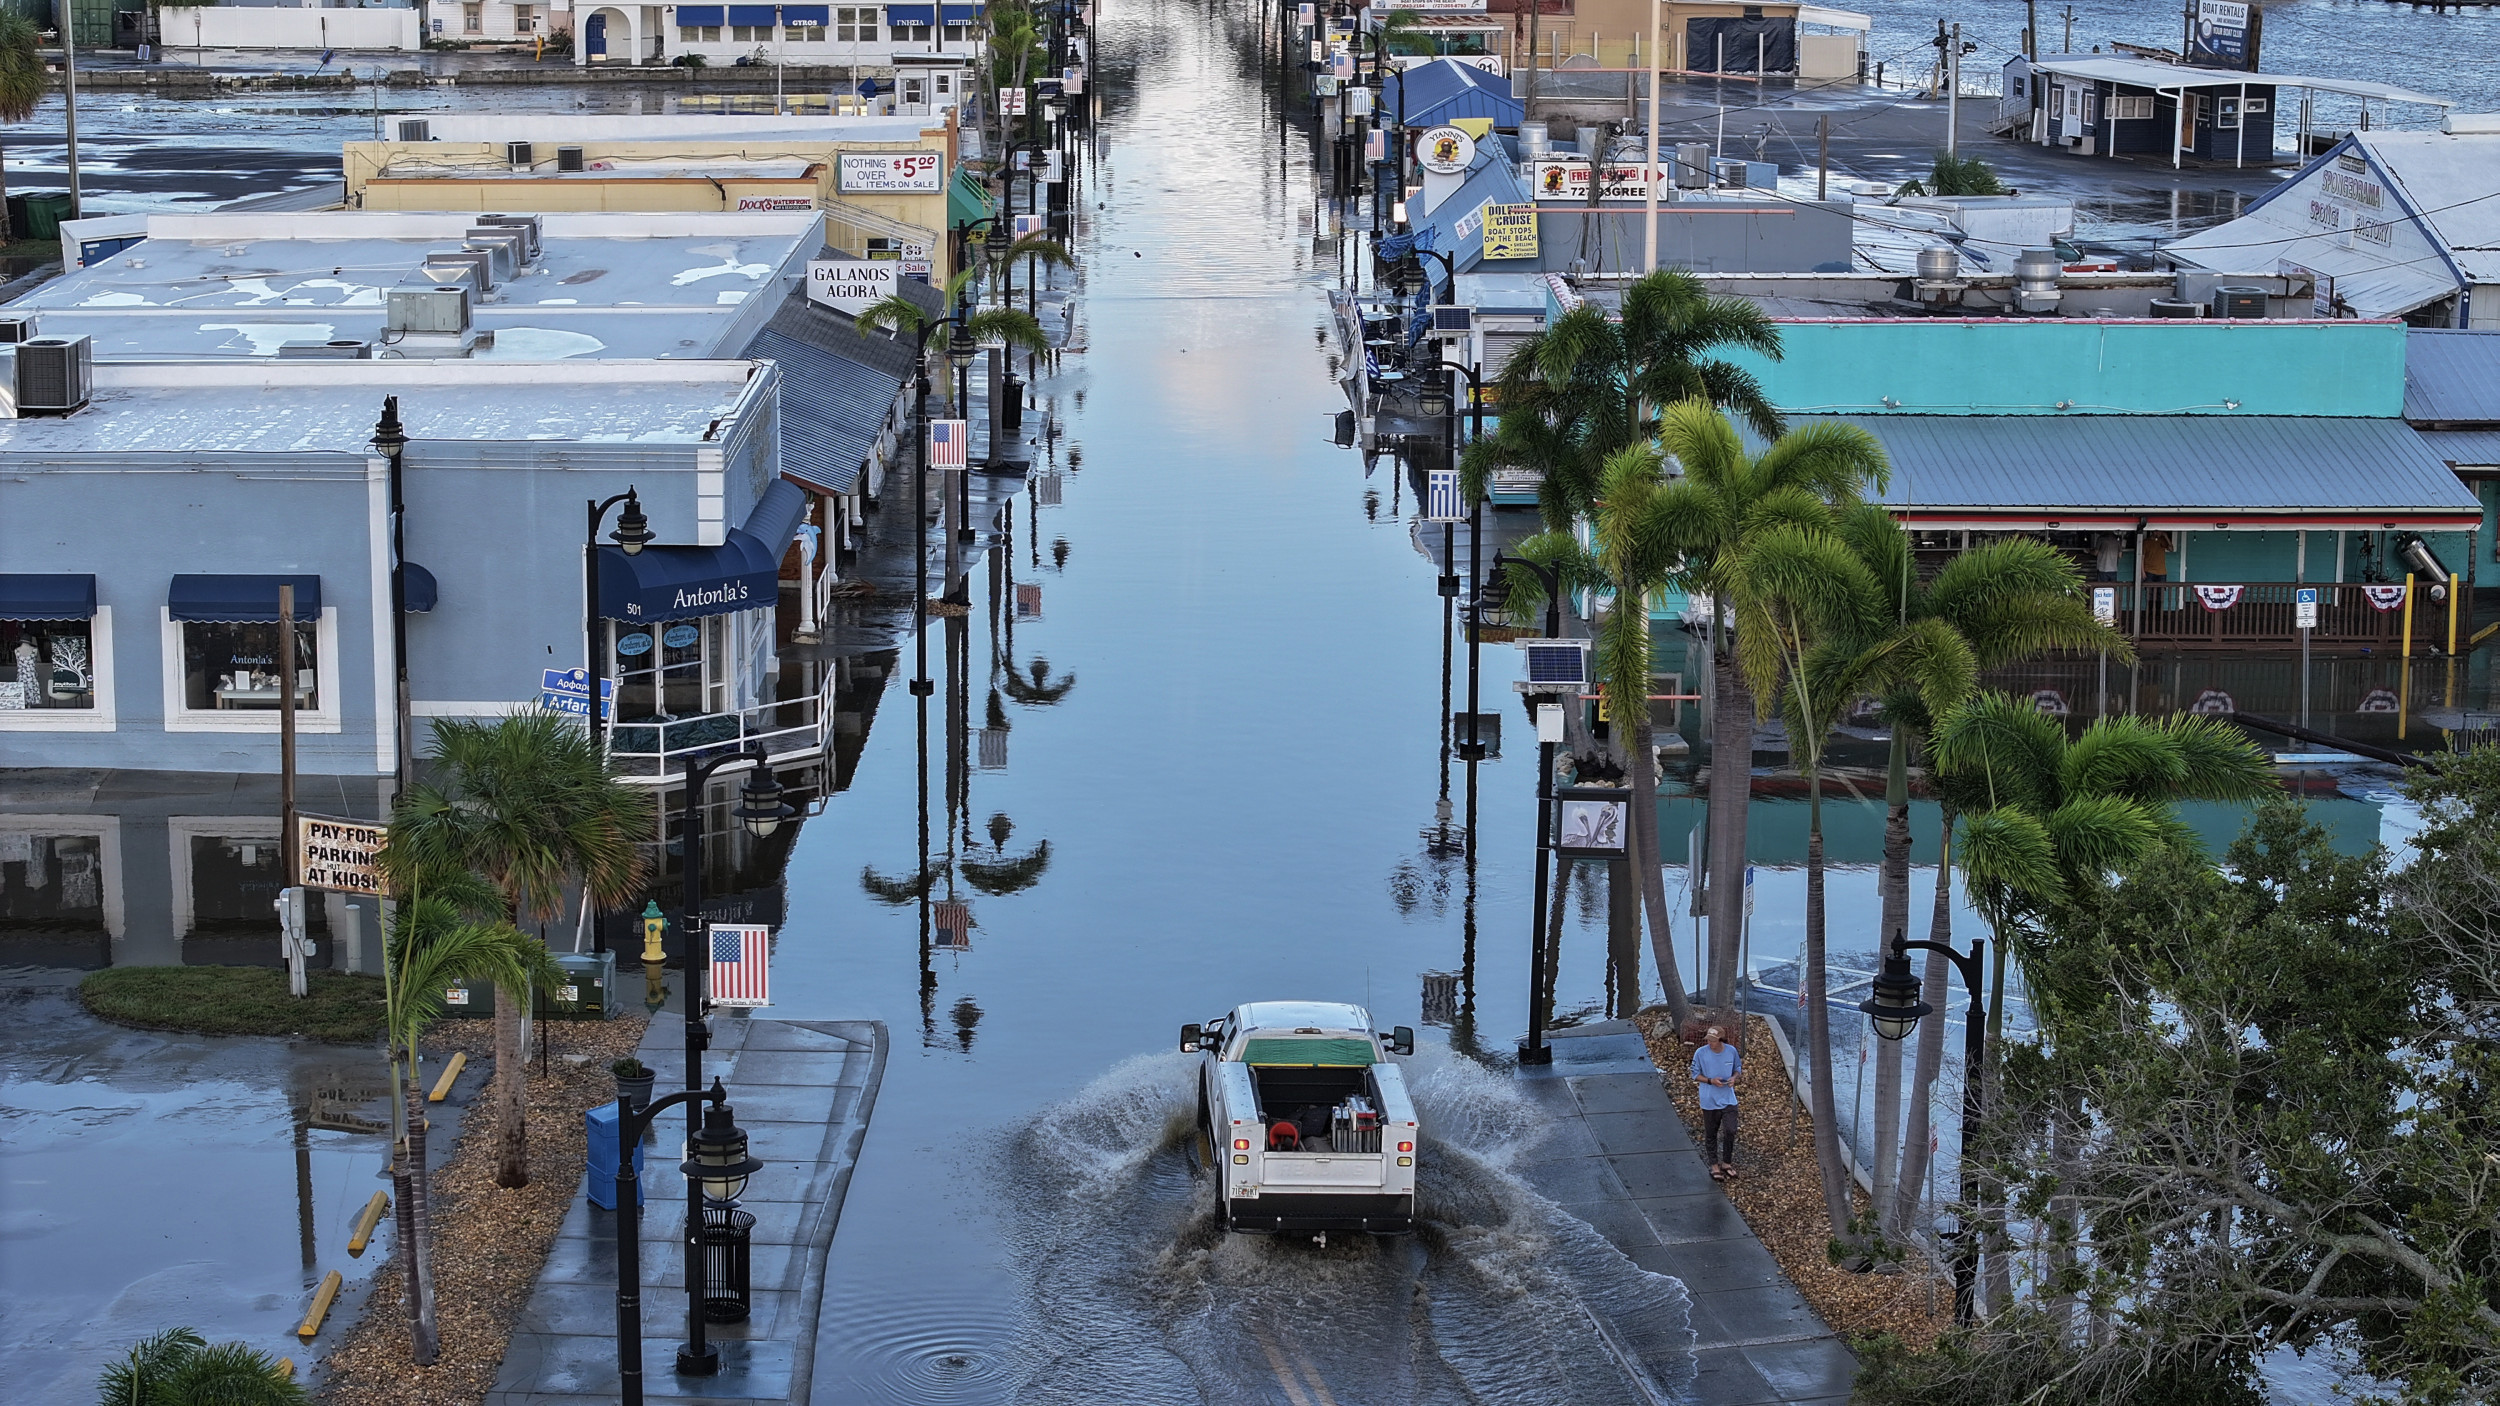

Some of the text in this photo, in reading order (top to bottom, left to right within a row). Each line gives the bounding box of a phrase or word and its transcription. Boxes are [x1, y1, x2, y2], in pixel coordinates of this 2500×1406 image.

[2202, 2, 2245, 19] BOAT RENTALS
[843, 159, 886, 169] NOTHING
[857, 171, 886, 180] OVER
[1601, 169, 1636, 180] ARKING
[738, 198, 772, 212] DOCK'S
[1496, 215, 1532, 226] CRUISE
[814, 267, 890, 281] GALANOS
[904, 263, 926, 271] Sale
[826, 284, 878, 298] AGORA
[673, 579, 748, 609] Antonia's
[627, 602, 641, 616] 501
[230, 654, 273, 665] Antonia's
[310, 823, 377, 845] PAY FOR
[327, 862, 340, 871] HUT
[308, 868, 326, 883] AT
